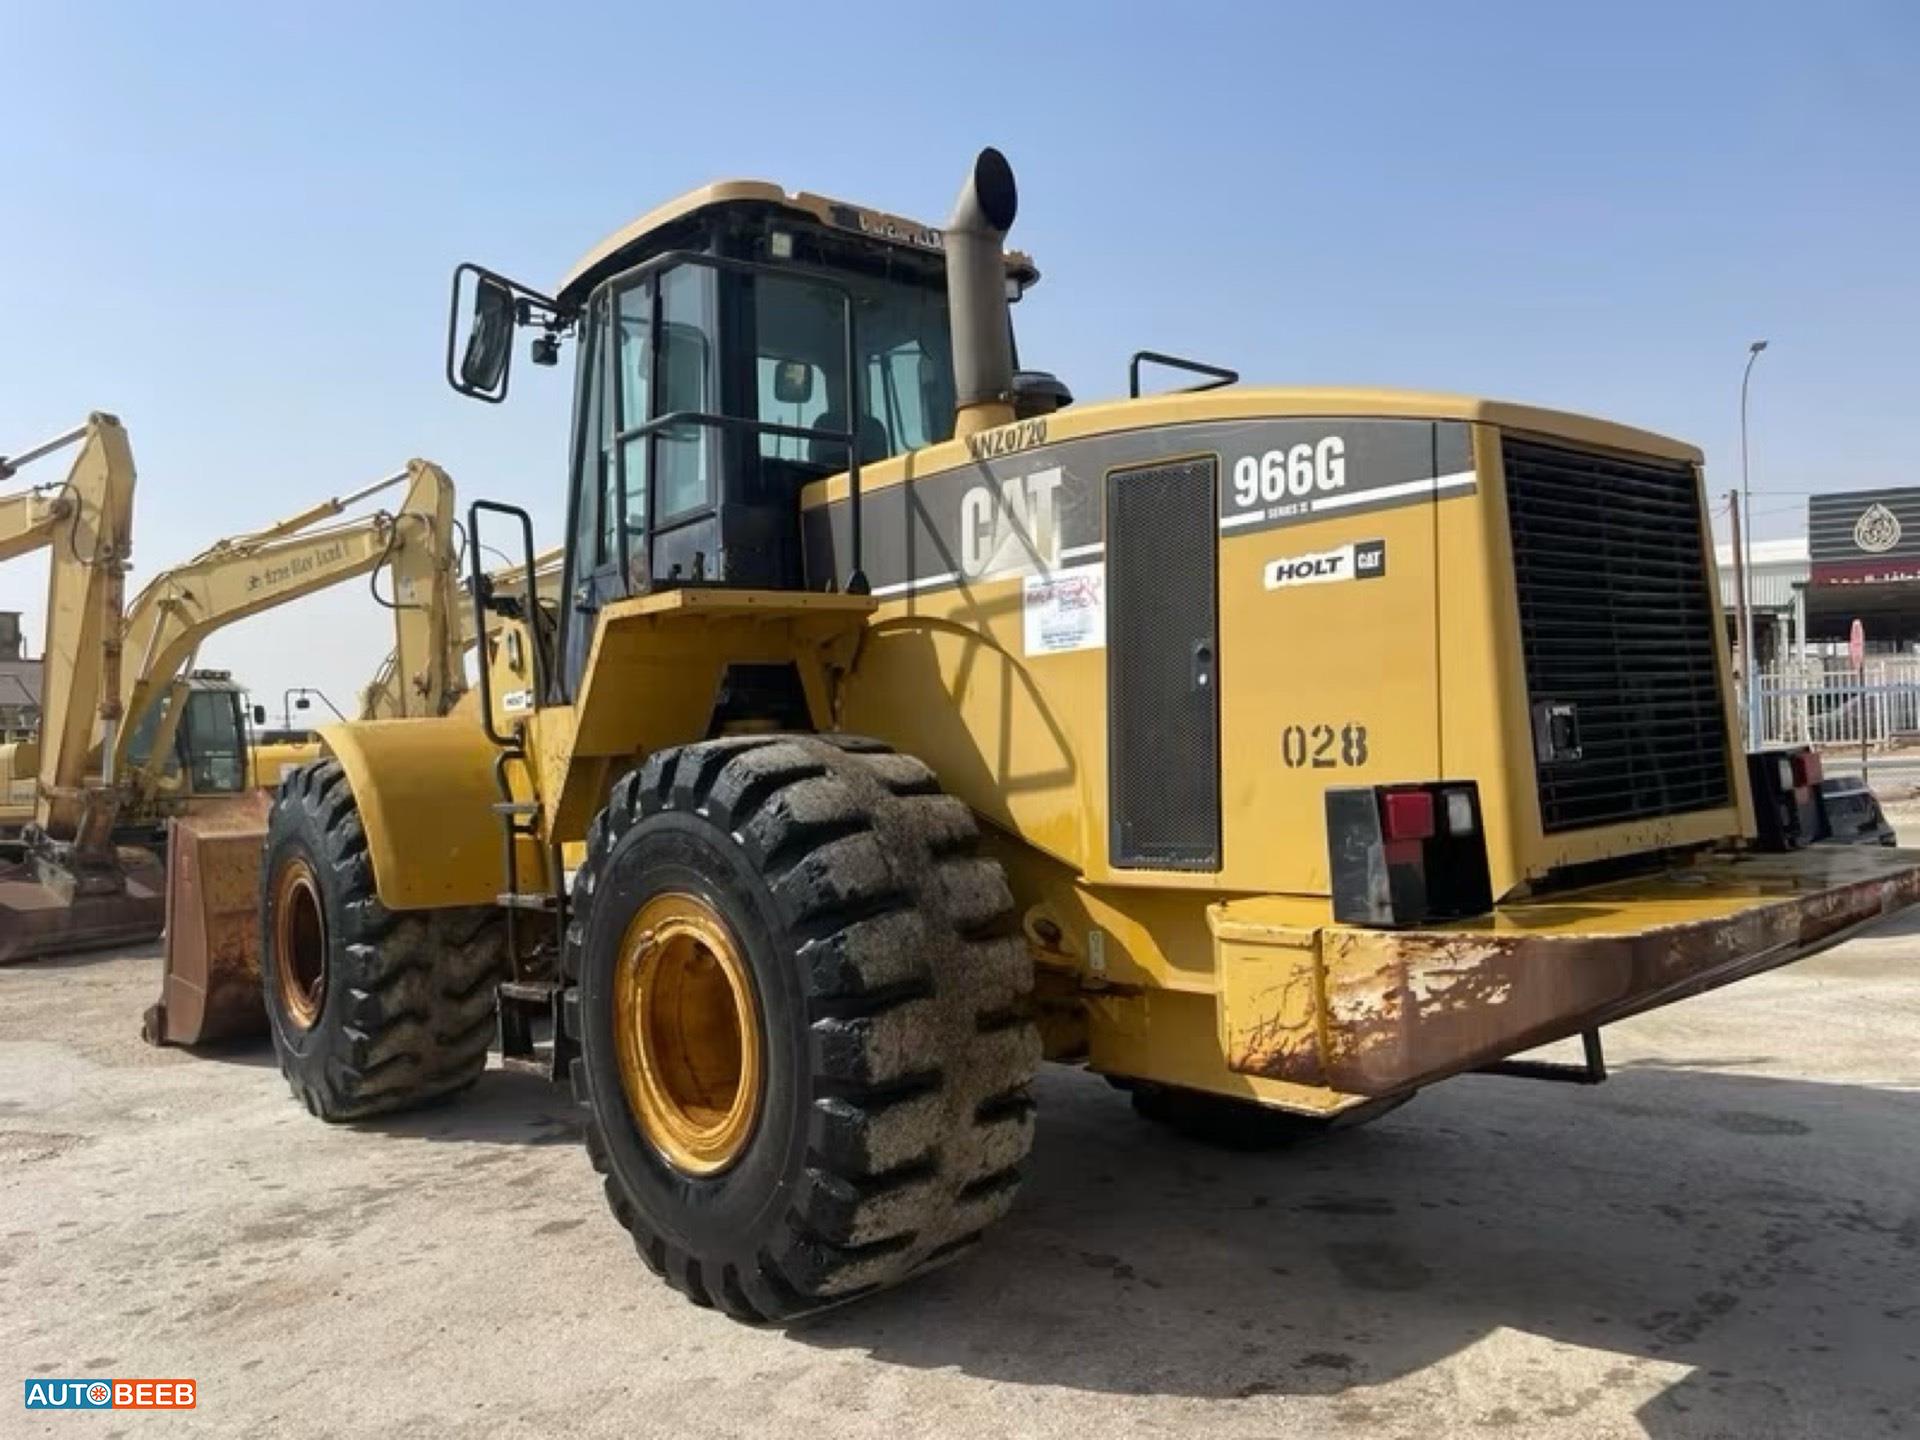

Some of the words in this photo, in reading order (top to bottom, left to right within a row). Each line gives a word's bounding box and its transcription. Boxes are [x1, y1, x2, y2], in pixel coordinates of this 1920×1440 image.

[1234, 436, 1345, 507] 966G
[962, 467, 1061, 577] CAT
[1276, 556, 1343, 582] HOLT
[1358, 551, 1383, 569] CAT
[1283, 723, 1368, 768] 028
